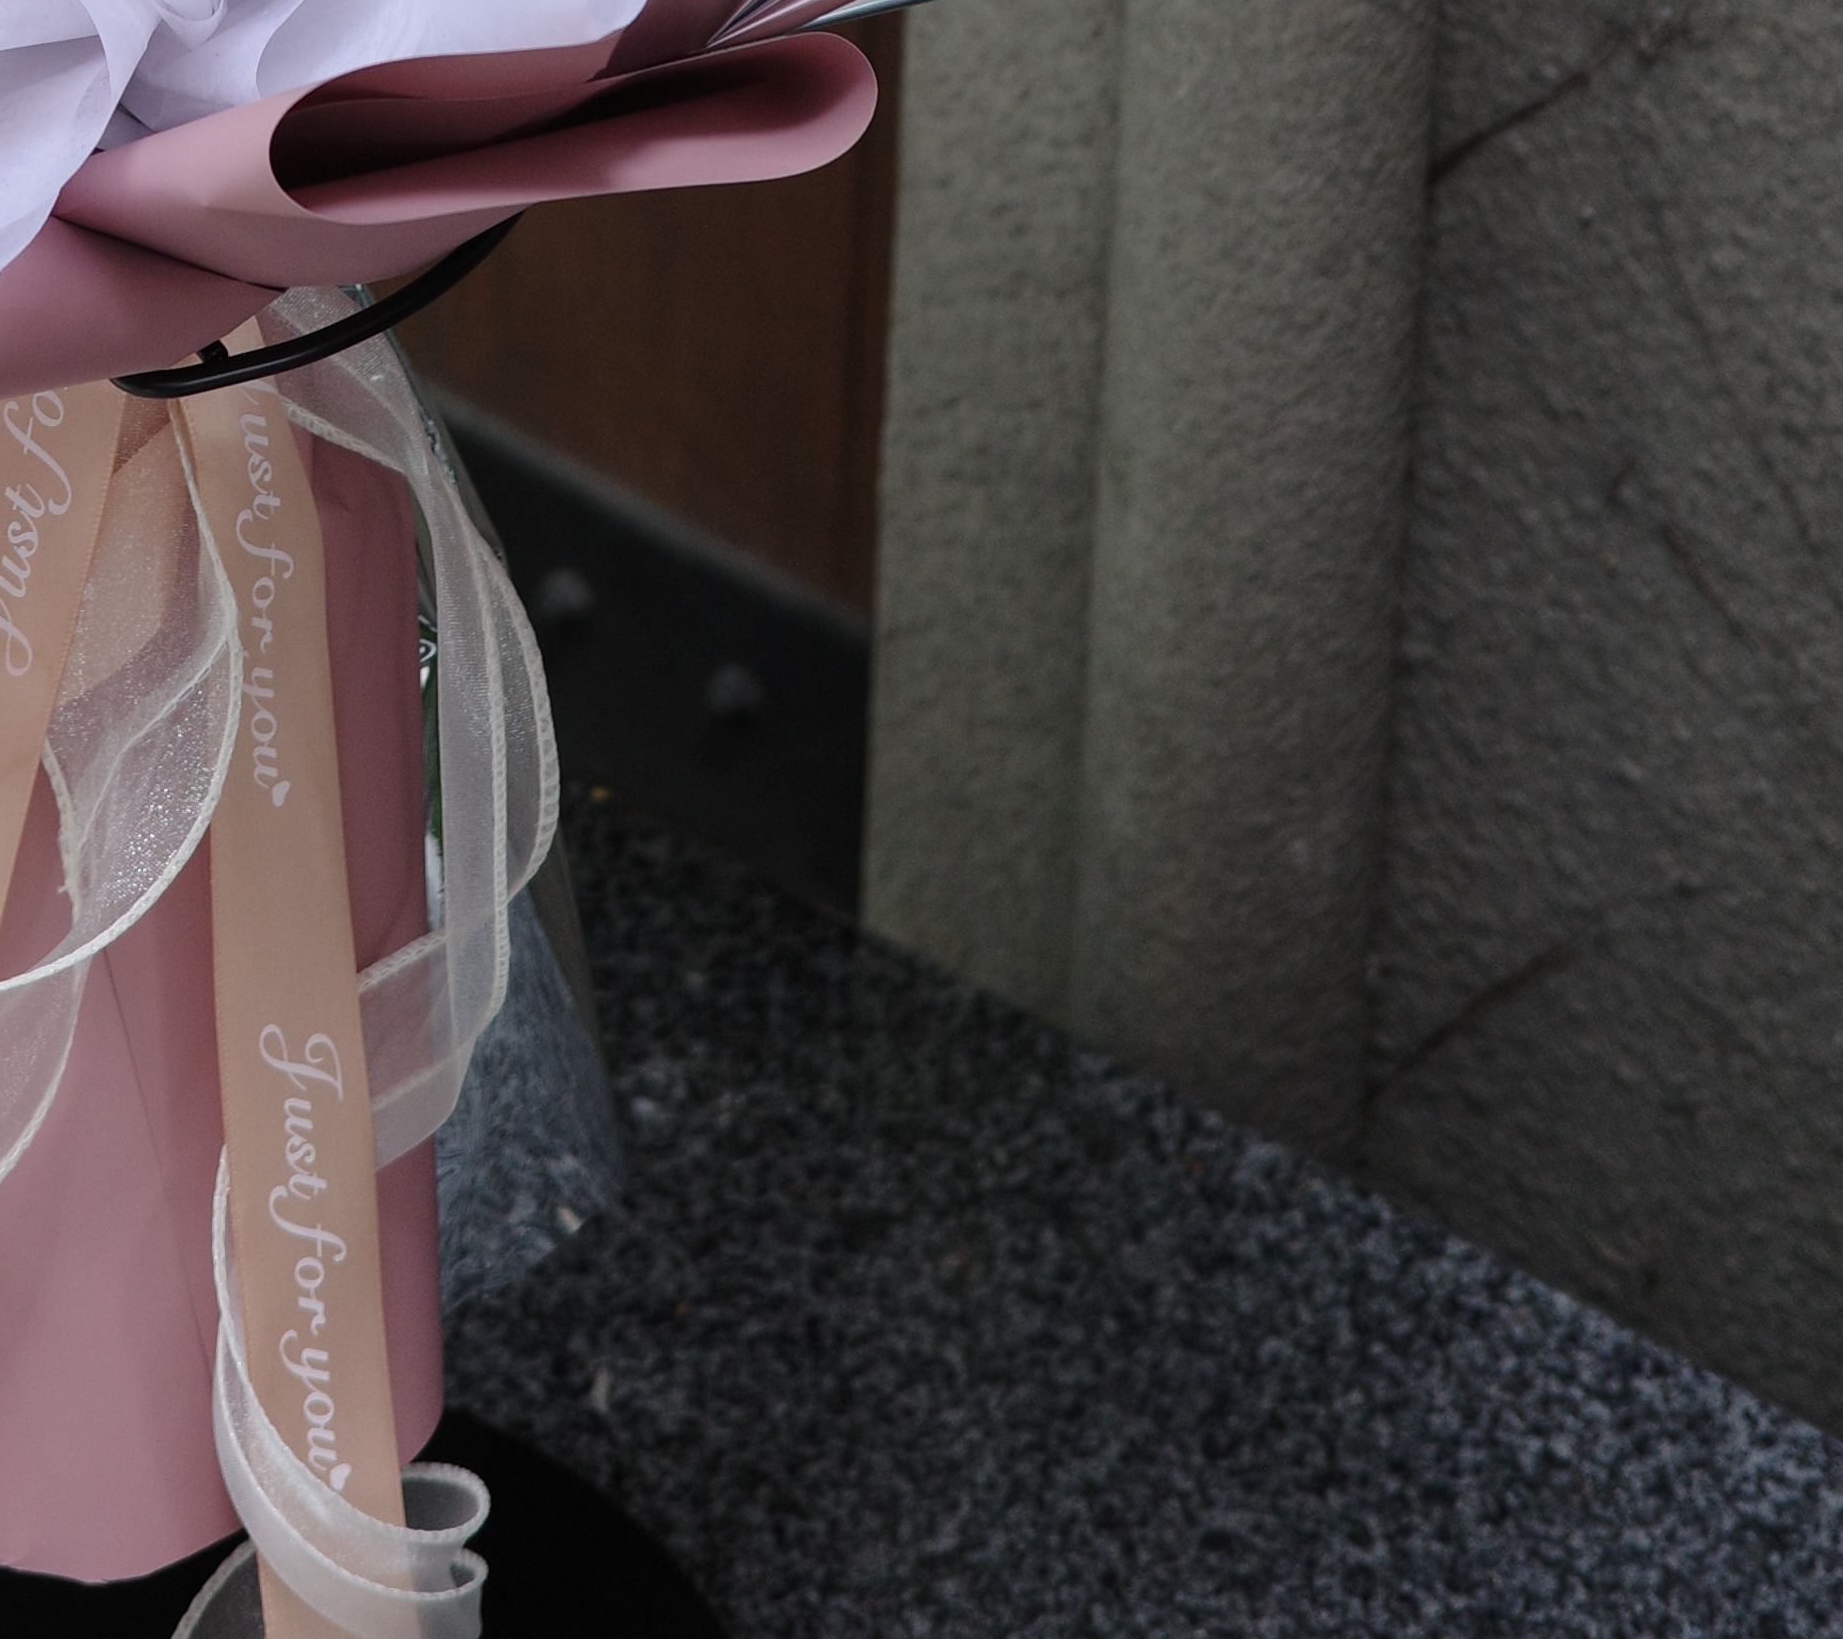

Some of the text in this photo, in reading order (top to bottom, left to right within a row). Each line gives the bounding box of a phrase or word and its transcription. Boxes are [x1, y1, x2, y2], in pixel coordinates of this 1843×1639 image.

[3, 388, 72, 515] fo
[236, 509, 294, 653] for
[242, 649, 279, 789] you
[259, 1023, 347, 1471] Just for you
